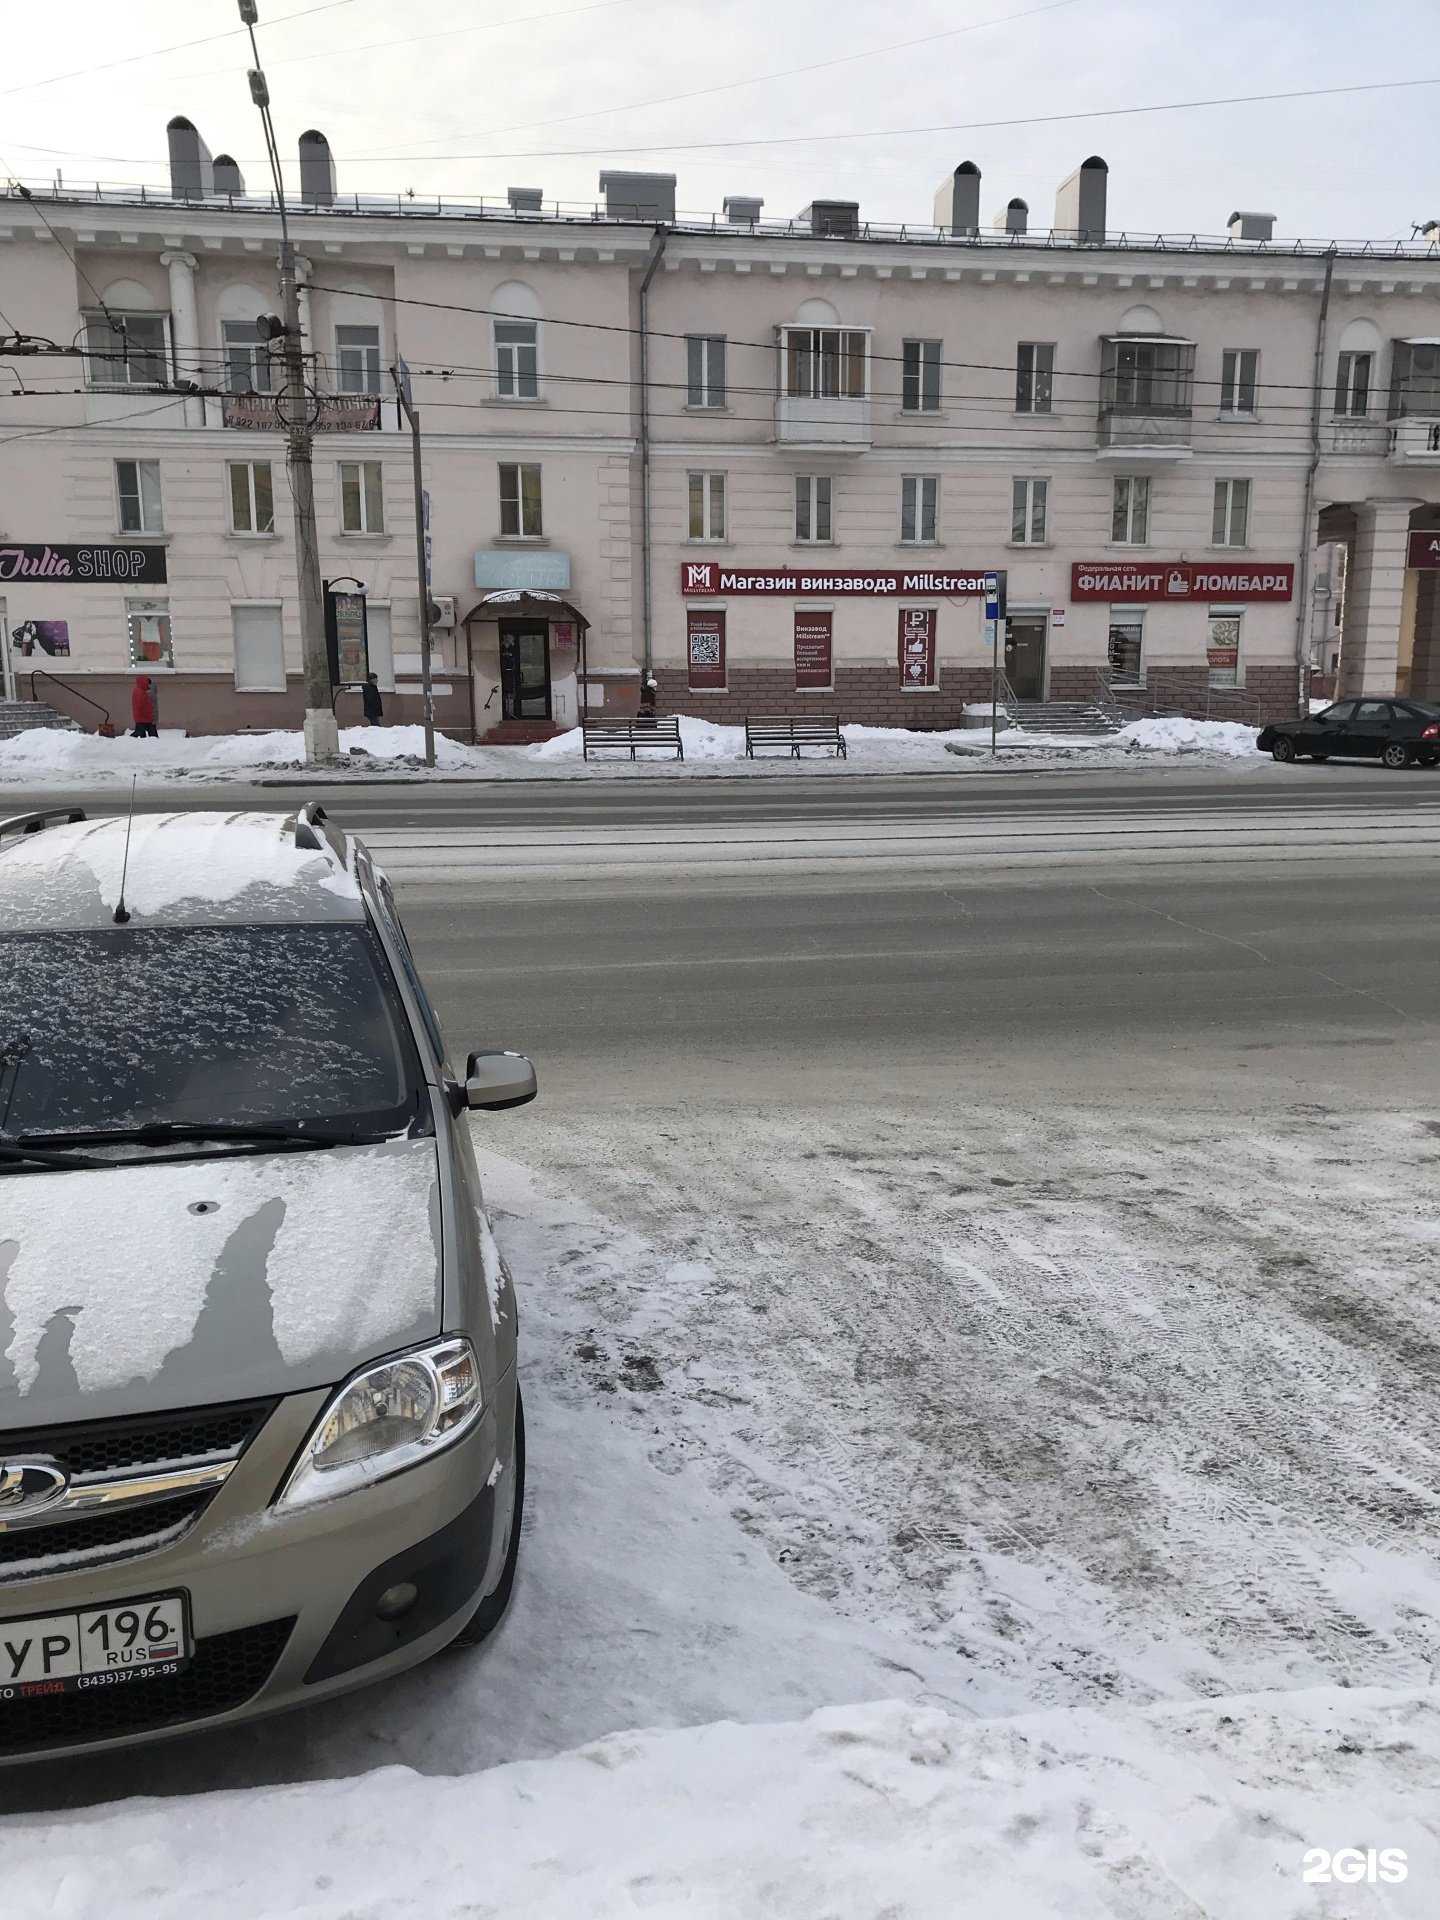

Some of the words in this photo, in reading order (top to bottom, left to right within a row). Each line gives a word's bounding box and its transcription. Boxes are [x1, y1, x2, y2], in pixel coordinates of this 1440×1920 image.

[0, 546, 73, 579] Julia
[77, 550, 146, 577] SHOP
[1078, 564, 1121, 573] Федеральная
[720, 574, 796, 590] Магазин
[801, 576, 897, 593] винзавода
[1078, 575, 1163, 591] ФИАНИТ
[1193, 575, 1288, 591] ЛОМБАРД
[87, 1605, 169, 1651] 196
[106, 1648, 147, 1665] RUS
[77, 1663, 178, 1690] (3435)37-95-95
